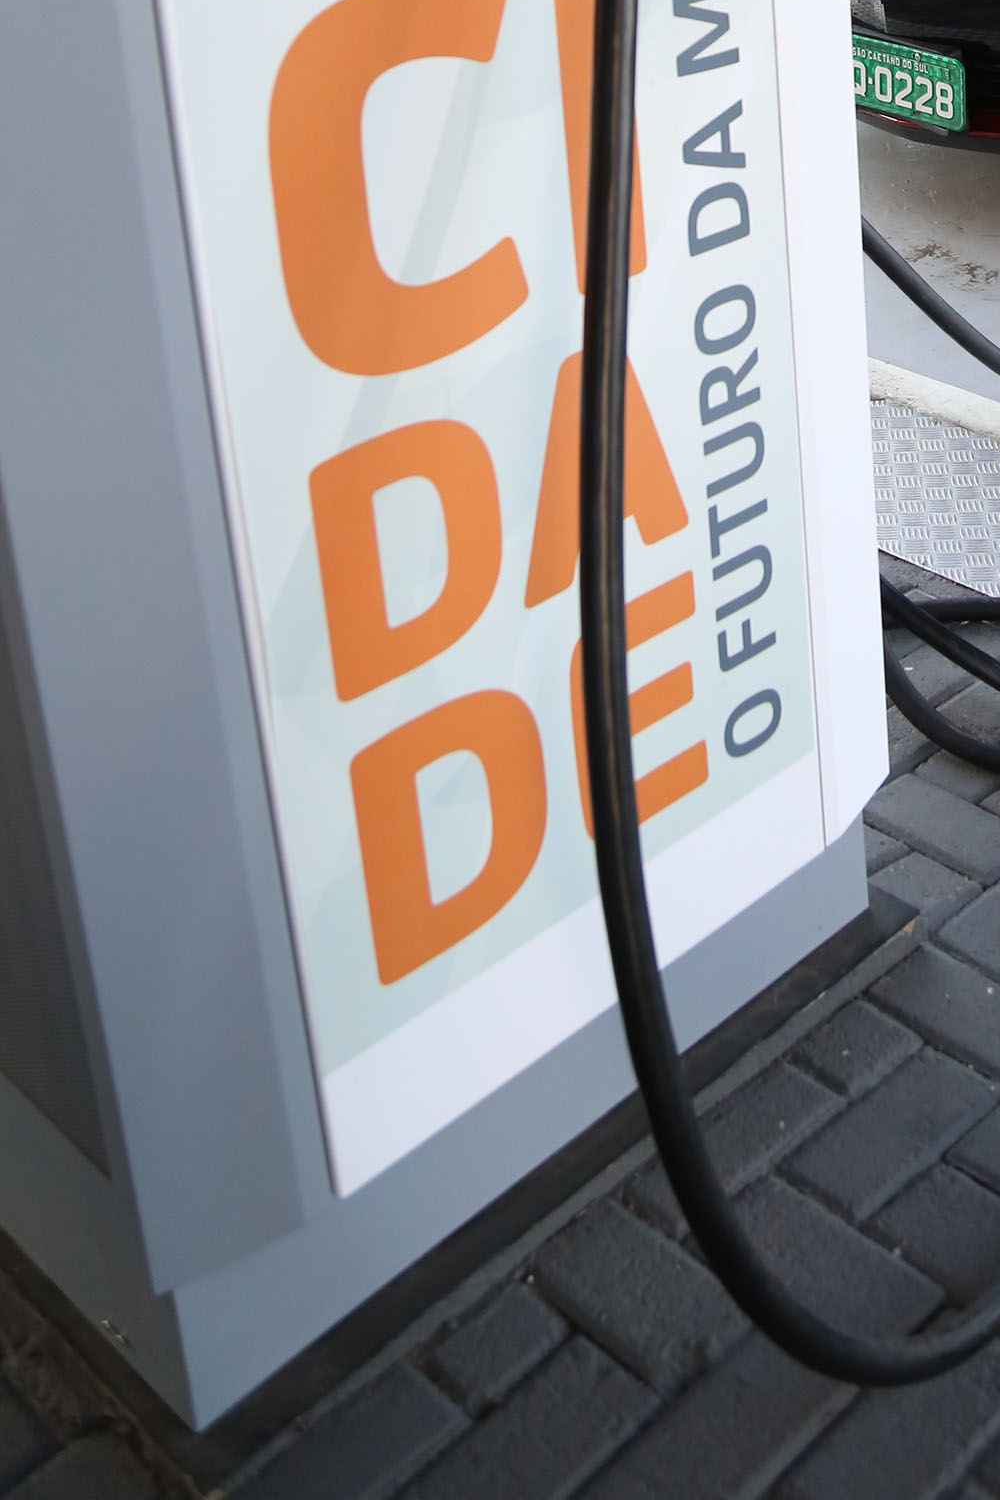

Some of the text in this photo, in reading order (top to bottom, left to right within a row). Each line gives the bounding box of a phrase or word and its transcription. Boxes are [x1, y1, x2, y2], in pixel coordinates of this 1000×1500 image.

[682, 99, 751, 258] DA
[308, 350, 689, 704] DA
[693, 283, 777, 673] FUTURO
[349, 570, 709, 987] DE
[723, 687, 783, 759] O
